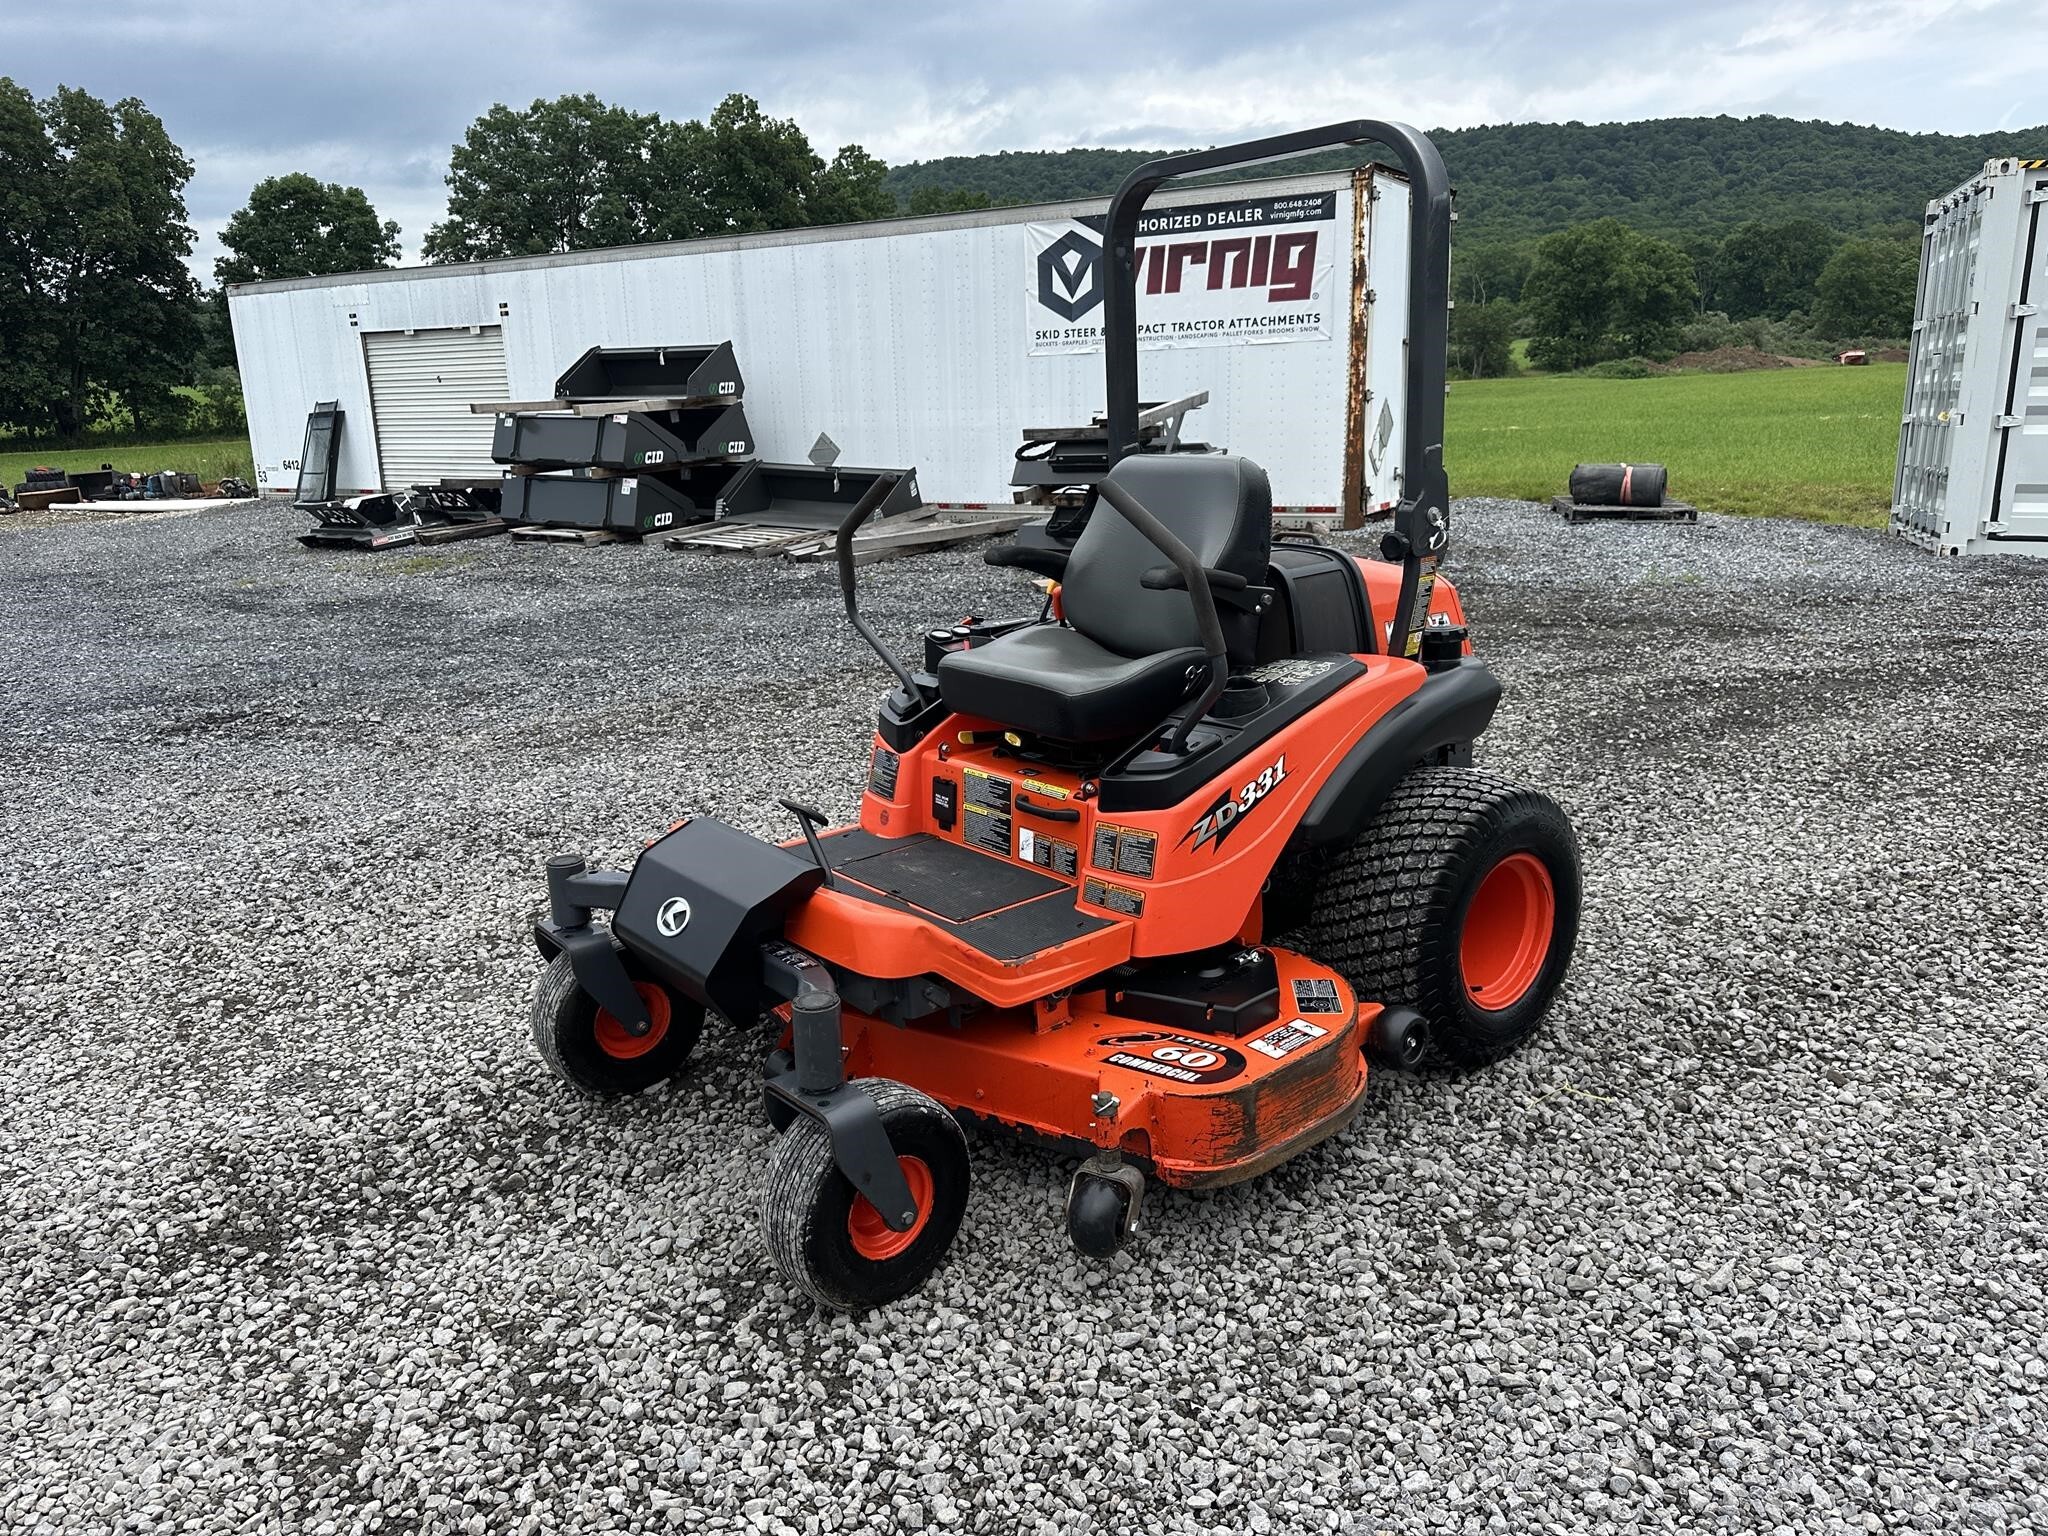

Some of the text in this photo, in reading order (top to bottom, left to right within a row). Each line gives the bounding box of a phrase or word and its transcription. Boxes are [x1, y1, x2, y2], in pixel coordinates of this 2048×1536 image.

[1274, 198, 1322, 209] 800.648.2408
[1138, 208, 1263, 232] HORIZED DEALER
[1270, 209, 1322, 220] virnigmfg.com
[1035, 330, 1060, 340] SKID
[1064, 328, 1097, 338] STEER
[1137, 323, 1166, 334] PACT
[1171, 320, 1225, 332] TRACTOR
[1228, 313, 1321, 329] ATTACHMENTS
[718, 381, 736, 395] CID
[727, 441, 746, 454] CID
[644, 450, 664, 464] CID
[283, 459, 300, 471] 6412
[257, 470, 268, 483] 53
[654, 512, 673, 527] CID
[1151, 1045, 1218, 1068] 60
[1108, 1053, 1203, 1083] COMMERCIAL
